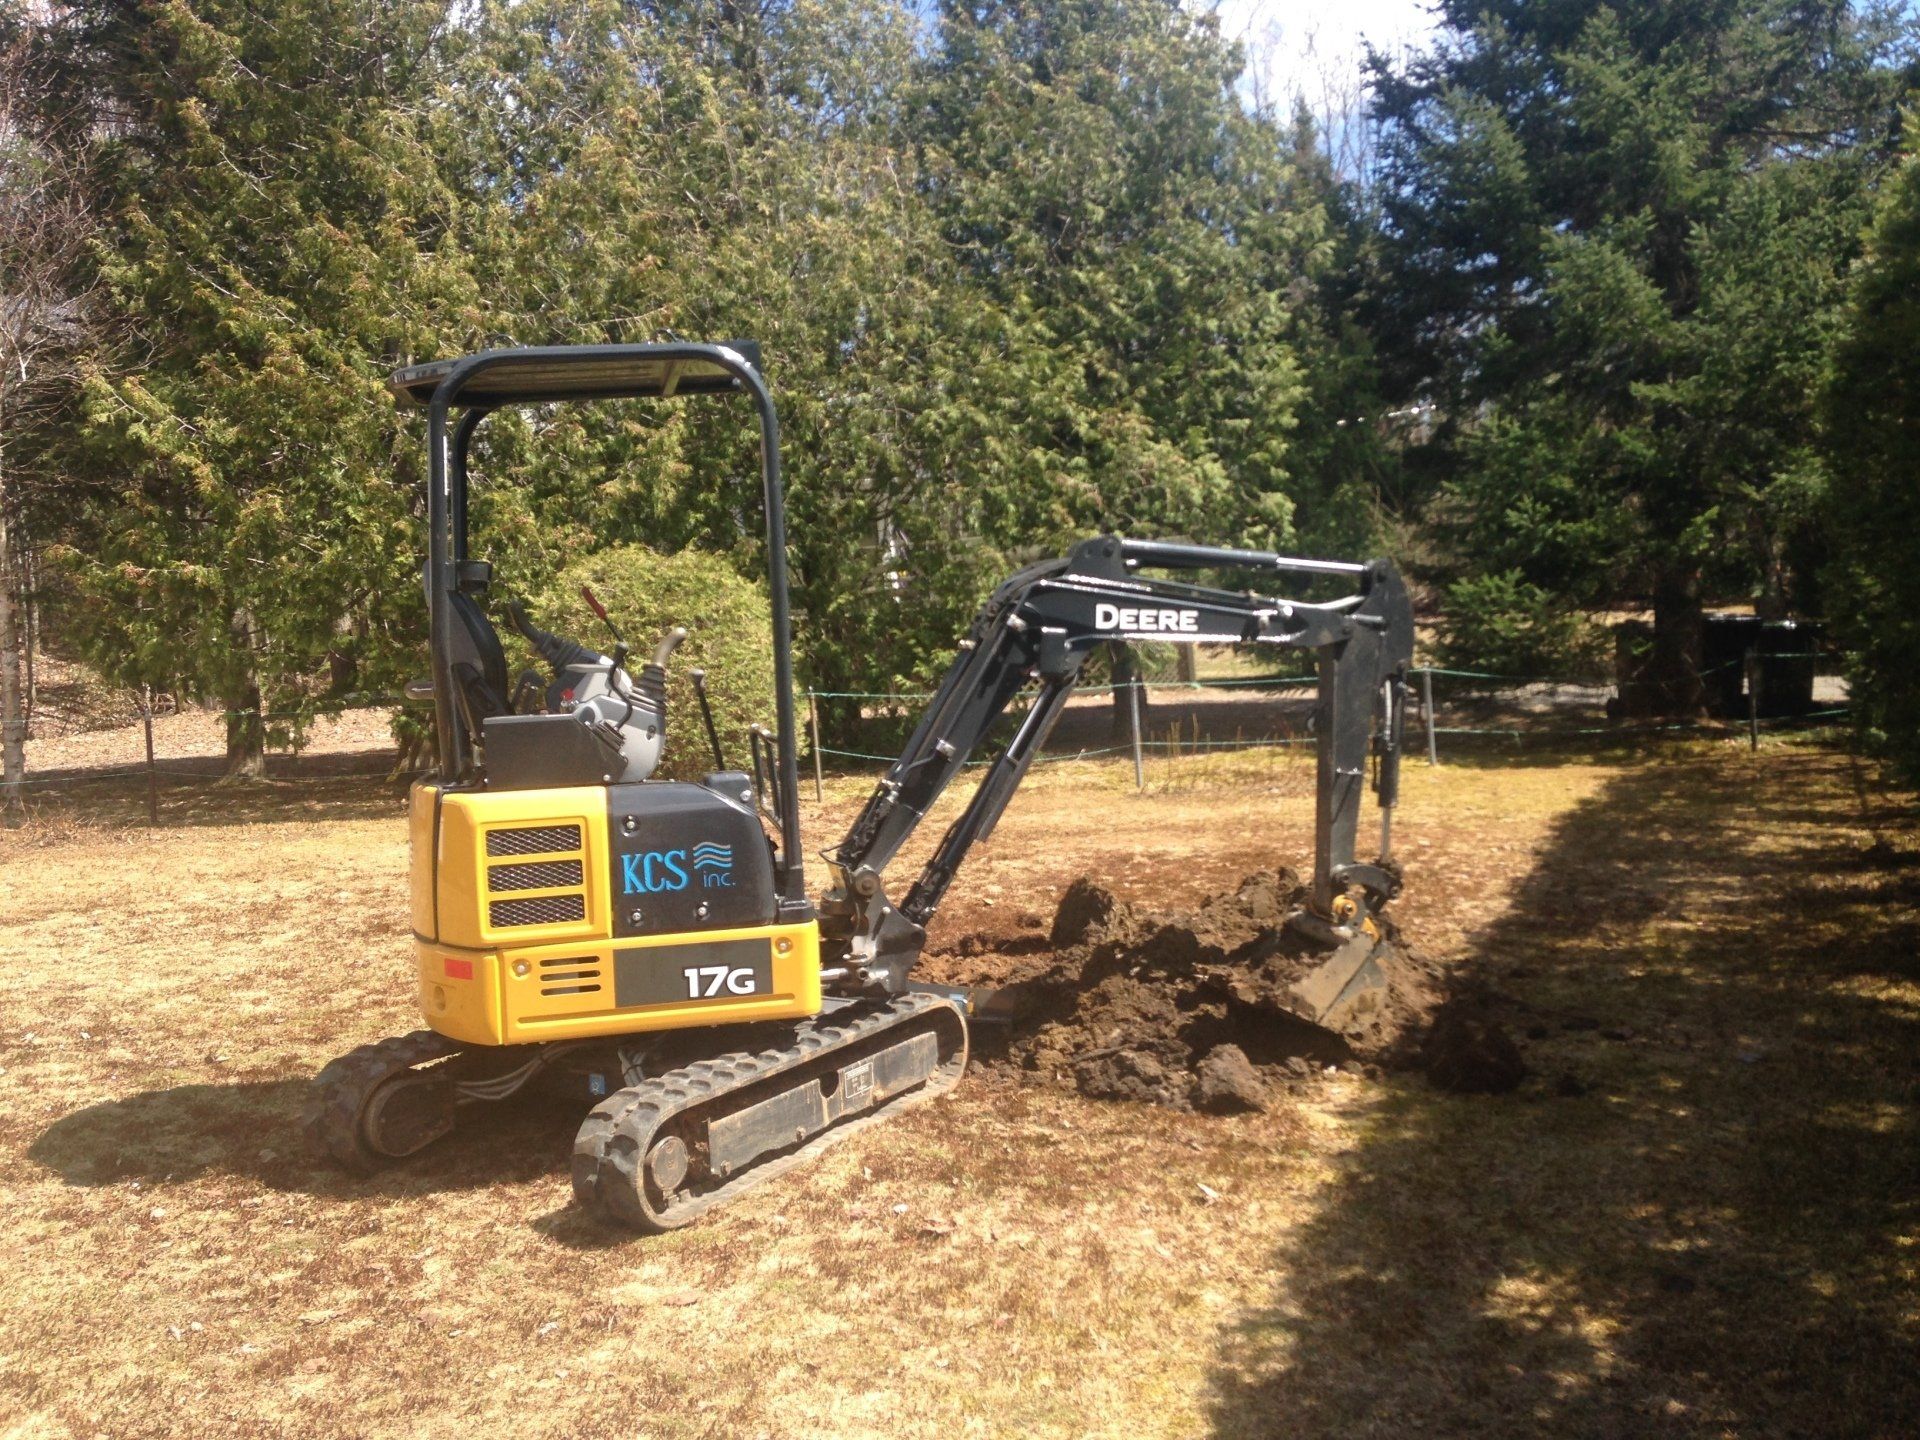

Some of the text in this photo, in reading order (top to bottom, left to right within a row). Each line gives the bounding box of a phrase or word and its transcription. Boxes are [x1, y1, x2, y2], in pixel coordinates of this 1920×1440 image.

[1095, 603, 1199, 632] DEERE
[621, 850, 690, 894] KCS
[684, 965, 755, 998] 17G
